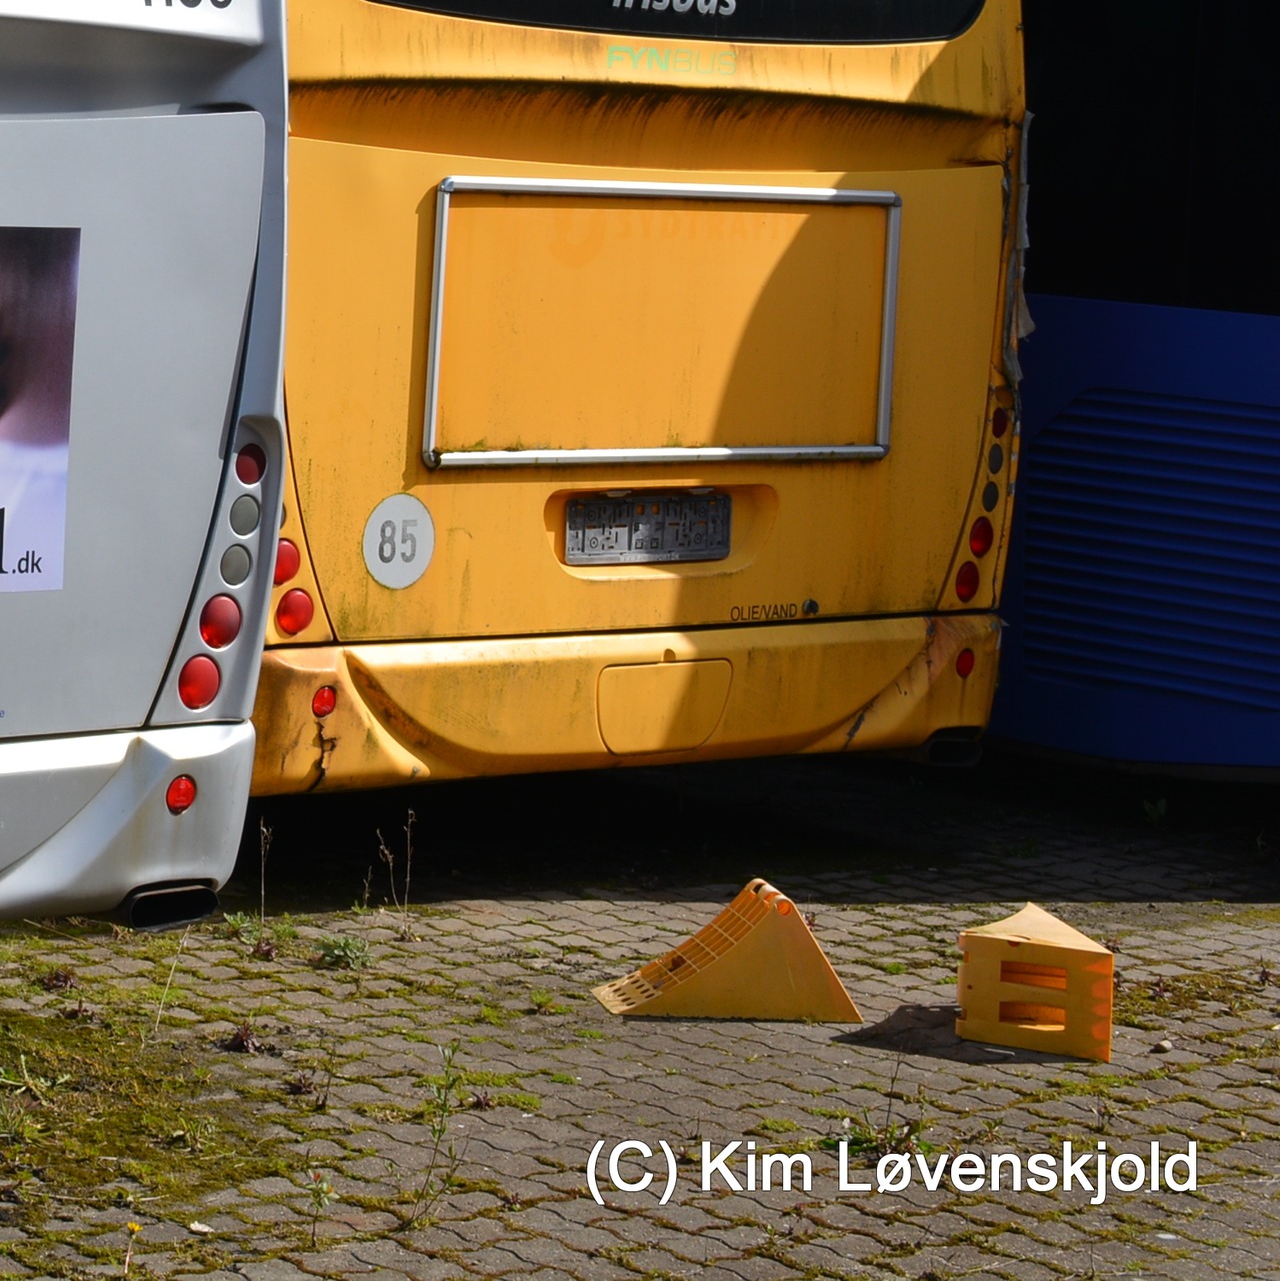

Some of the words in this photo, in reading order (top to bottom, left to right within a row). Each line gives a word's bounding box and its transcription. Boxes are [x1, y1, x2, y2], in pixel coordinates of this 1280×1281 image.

[607, 45, 737, 76] FYNBUS
[378, 519, 418, 564] 85
[730, 603, 798, 621] OLIE/VAND
